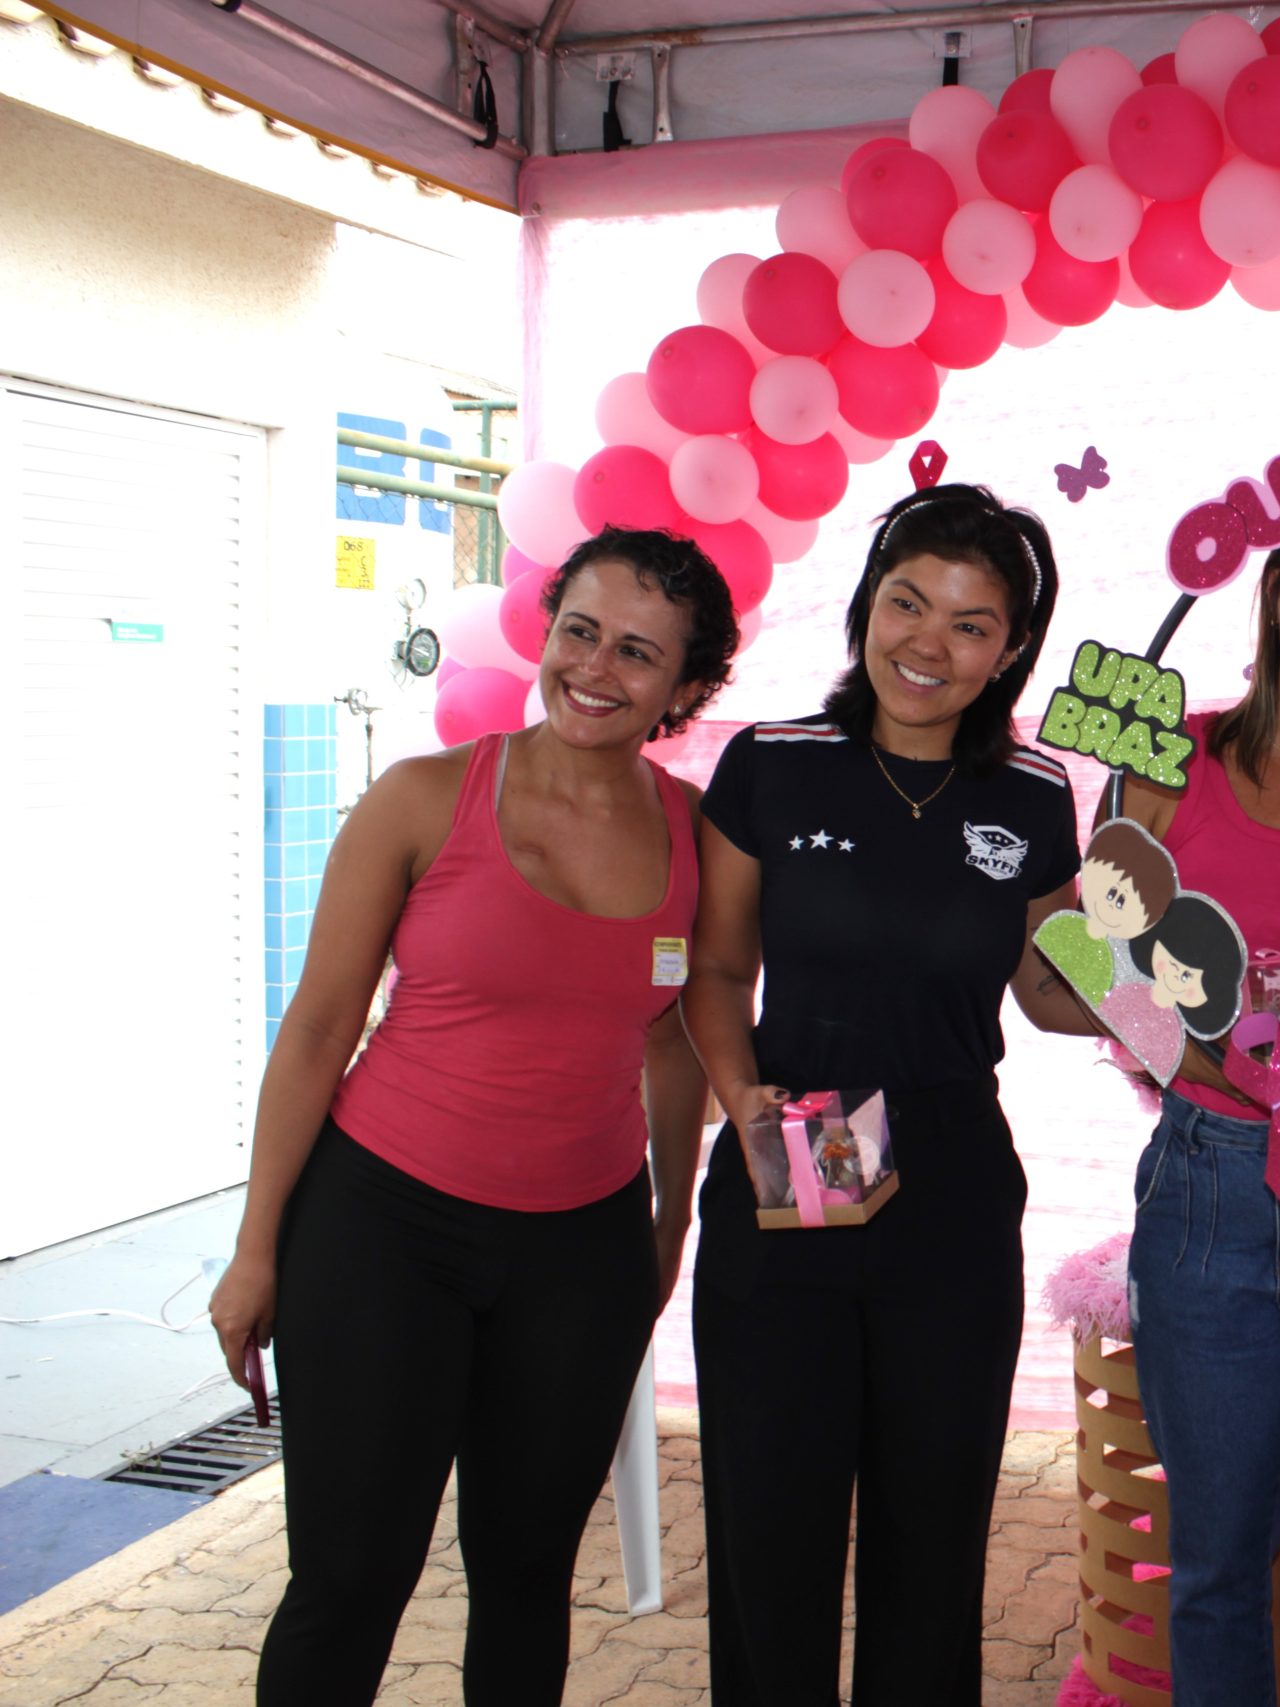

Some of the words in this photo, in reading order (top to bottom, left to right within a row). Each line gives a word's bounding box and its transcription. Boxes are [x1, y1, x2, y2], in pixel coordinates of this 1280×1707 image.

[1071, 642, 1183, 729] UPA
[1039, 691, 1194, 788] BRAZ
[967, 855, 1020, 878] SKYFIT
